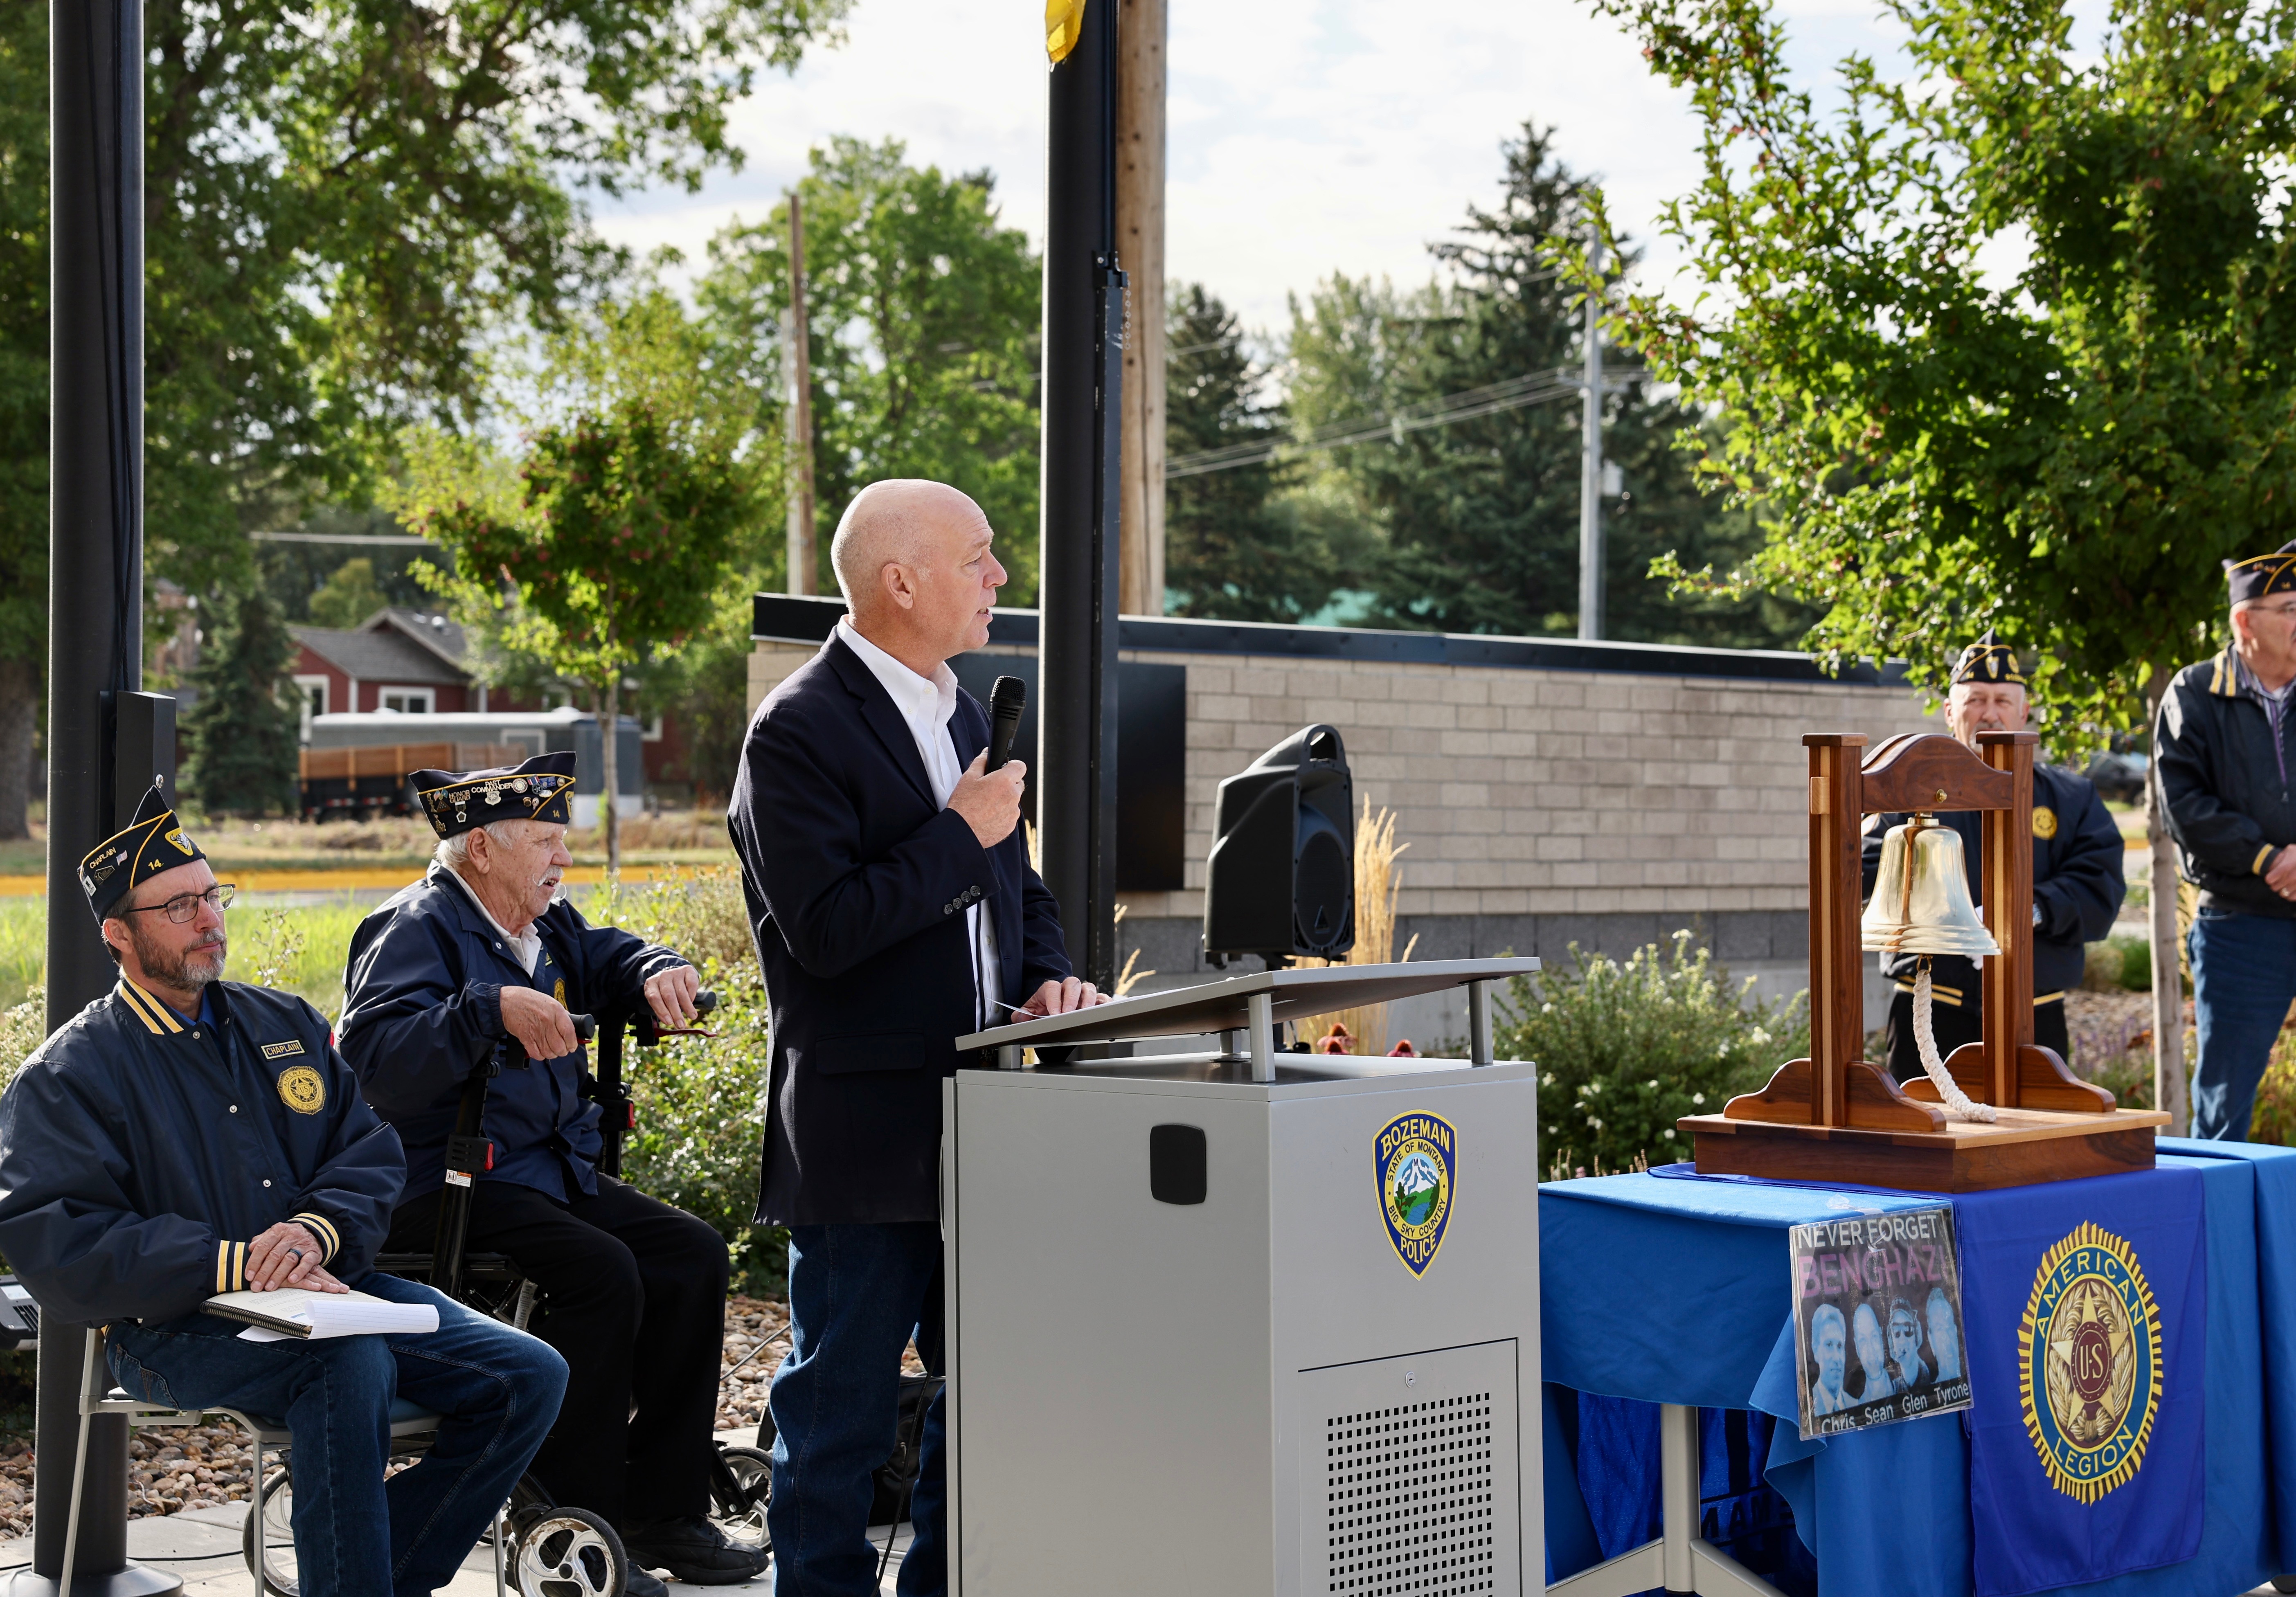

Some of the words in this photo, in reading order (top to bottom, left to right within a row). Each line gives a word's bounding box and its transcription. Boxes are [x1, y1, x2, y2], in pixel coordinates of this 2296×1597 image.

[471, 782, 513, 793] COMMANDER
[485, 779, 501, 787] PAST
[448, 790, 470, 798] HONOR
[450, 795, 470, 803] GUARD
[553, 810, 560, 818] 14
[89, 847, 116, 869] CHAPLAIN
[148, 859, 163, 871] 14
[266, 1043, 300, 1055] CHAPLAIN
[284, 1071, 319, 1087] AMERICAN
[296, 1099, 321, 1109] LEGION
[1381, 1118, 1450, 1161] BOZEMAN
[1387, 1150, 1403, 1182] STATE
[1405, 1142, 1414, 1153] OF
[1417, 1141, 1444, 1175] MONTANA
[1414, 1158, 1418, 1167] M
[1388, 1206, 1398, 1223] BIG
[1400, 1224, 1415, 1237] SKY
[1419, 1200, 1446, 1236] COUNTRY
[1798, 1221, 1864, 1248] NEVER
[1867, 1215, 1936, 1244] FORGET
[1400, 1231, 1436, 1264] POLICE
[1798, 1245, 1951, 1298] BENGHAZI
[2037, 1251, 2144, 1339] AMERICAN
[1821, 1413, 1855, 1433] Chris
[1865, 1404, 1894, 1425] Sean
[1902, 1394, 1928, 1414] Glen
[1934, 1383, 1969, 1406] Tyrone
[2054, 1424, 2133, 1476] LEGION
